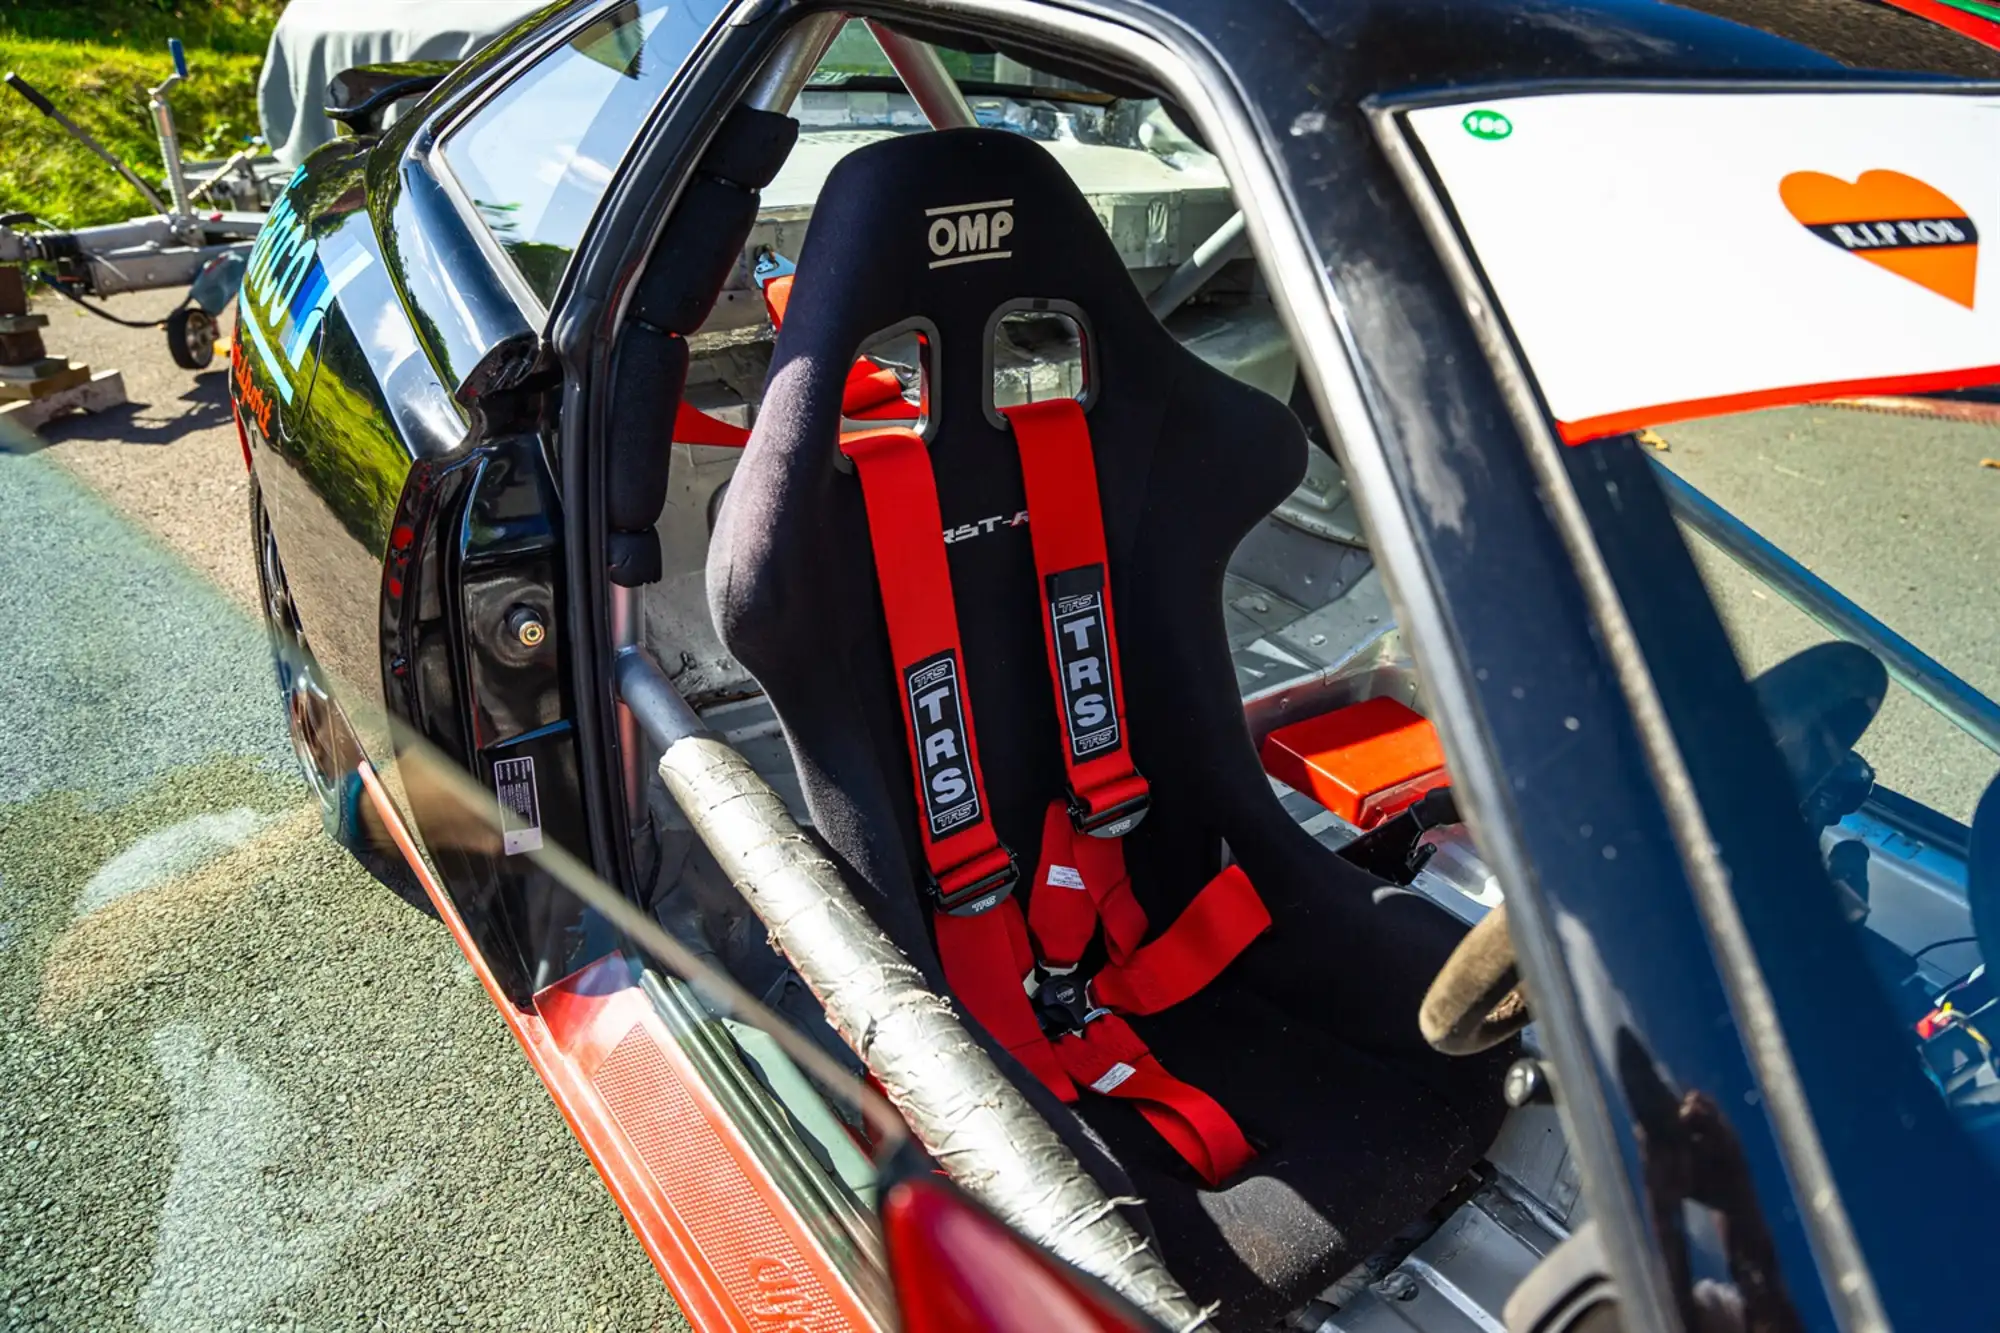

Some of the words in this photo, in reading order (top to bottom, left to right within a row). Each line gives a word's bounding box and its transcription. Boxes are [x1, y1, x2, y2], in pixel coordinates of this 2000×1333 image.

[928, 211, 1014, 256] OMP
[1898, 219, 1966, 245] ROB
[1058, 594, 1094, 614] TRS
[913, 663, 949, 688] TRS
[1063, 615, 1108, 728] TRS
[918, 685, 968, 805] TRS
[1079, 729, 1113, 750] TRS
[936, 803, 973, 828] TRS
[1109, 819, 1132, 835] TRS
[971, 895, 997, 913] TRS
